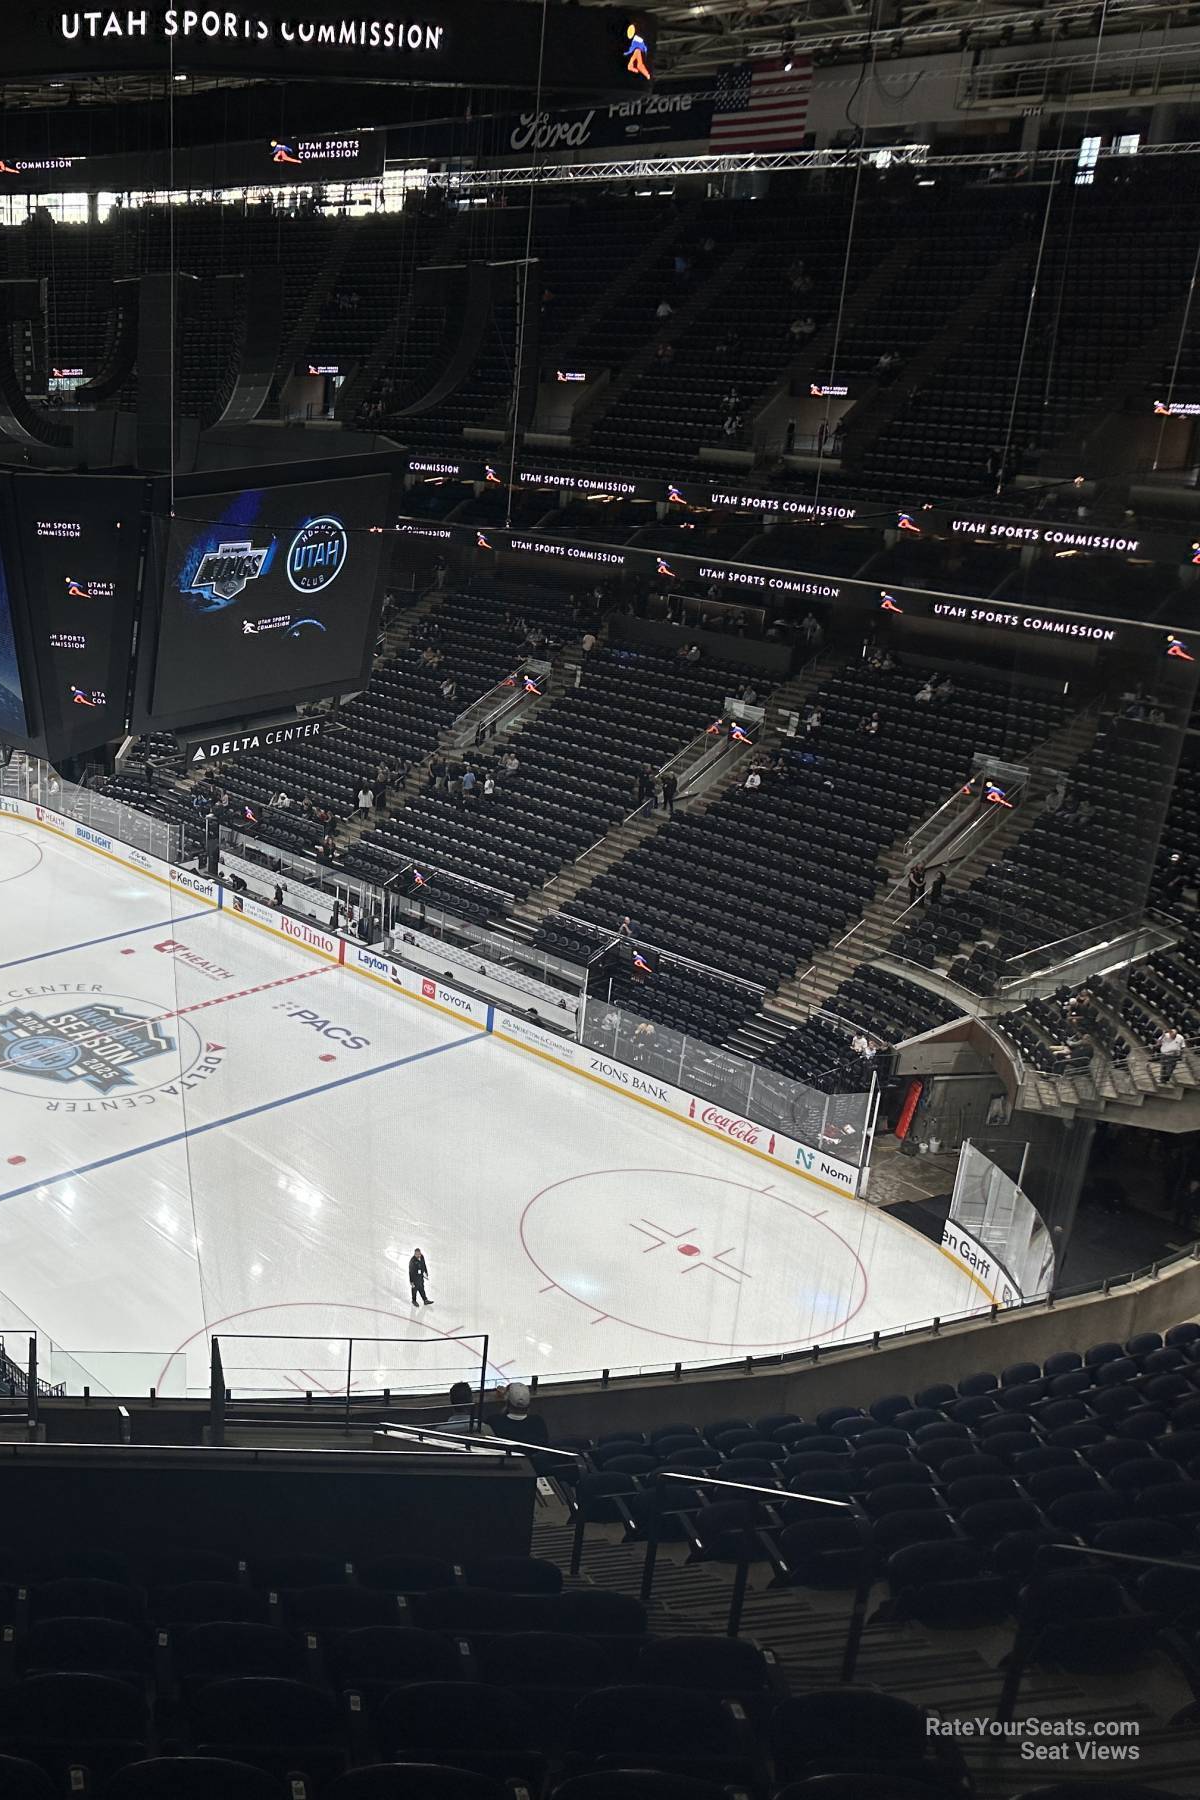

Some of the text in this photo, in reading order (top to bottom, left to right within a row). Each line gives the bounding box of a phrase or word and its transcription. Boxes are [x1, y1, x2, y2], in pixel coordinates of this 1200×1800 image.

[62, 11, 146, 38] UTAH
[510, 106, 596, 150] Ford
[645, 94, 692, 115] Zone
[298, 140, 360, 150] UTAH SPORTS
[298, 149, 360, 159] COMMISSION
[15, 160, 73, 170] COMMISSION
[409, 462, 459, 474] COMMISSION
[520, 473, 635, 493] UTAH SPORTS COMMISSION
[711, 494, 856, 518] UTAH SPORTS COMMISSION
[952, 521, 1138, 551] UTAH SPORTS COMMISSION
[294, 540, 339, 571] UTAH
[511, 540, 625, 563] UTAH SPORTS COMMISSION
[301, 574, 325, 587] CLUB
[699, 568, 840, 597] UTAH SPORTS COMMISSION
[934, 604, 1115, 640] UTAH SPORTS COMMISSION
[210, 723, 321, 757] DELTA CENTER
[76, 827, 112, 850] BUD LIGHT
[177, 871, 213, 897] Ken Garff
[180, 953, 235, 980] HEALTH
[358, 951, 388, 973] Layton
[8, 983, 104, 998] CENTER
[438, 990, 472, 1012] TOYOTA
[16, 1016, 51, 1034] 2024
[287, 1009, 370, 1050] PACS
[48, 1013, 142, 1066] SEASON
[82, 1058, 120, 1079] 2025
[160, 1055, 222, 1096] DELTA
[589, 1058, 668, 1102] ZIONS BANK
[46, 1094, 156, 1112] CENTER
[820, 1162, 853, 1185] Nomi
[959, 1240, 991, 1280] Garff
